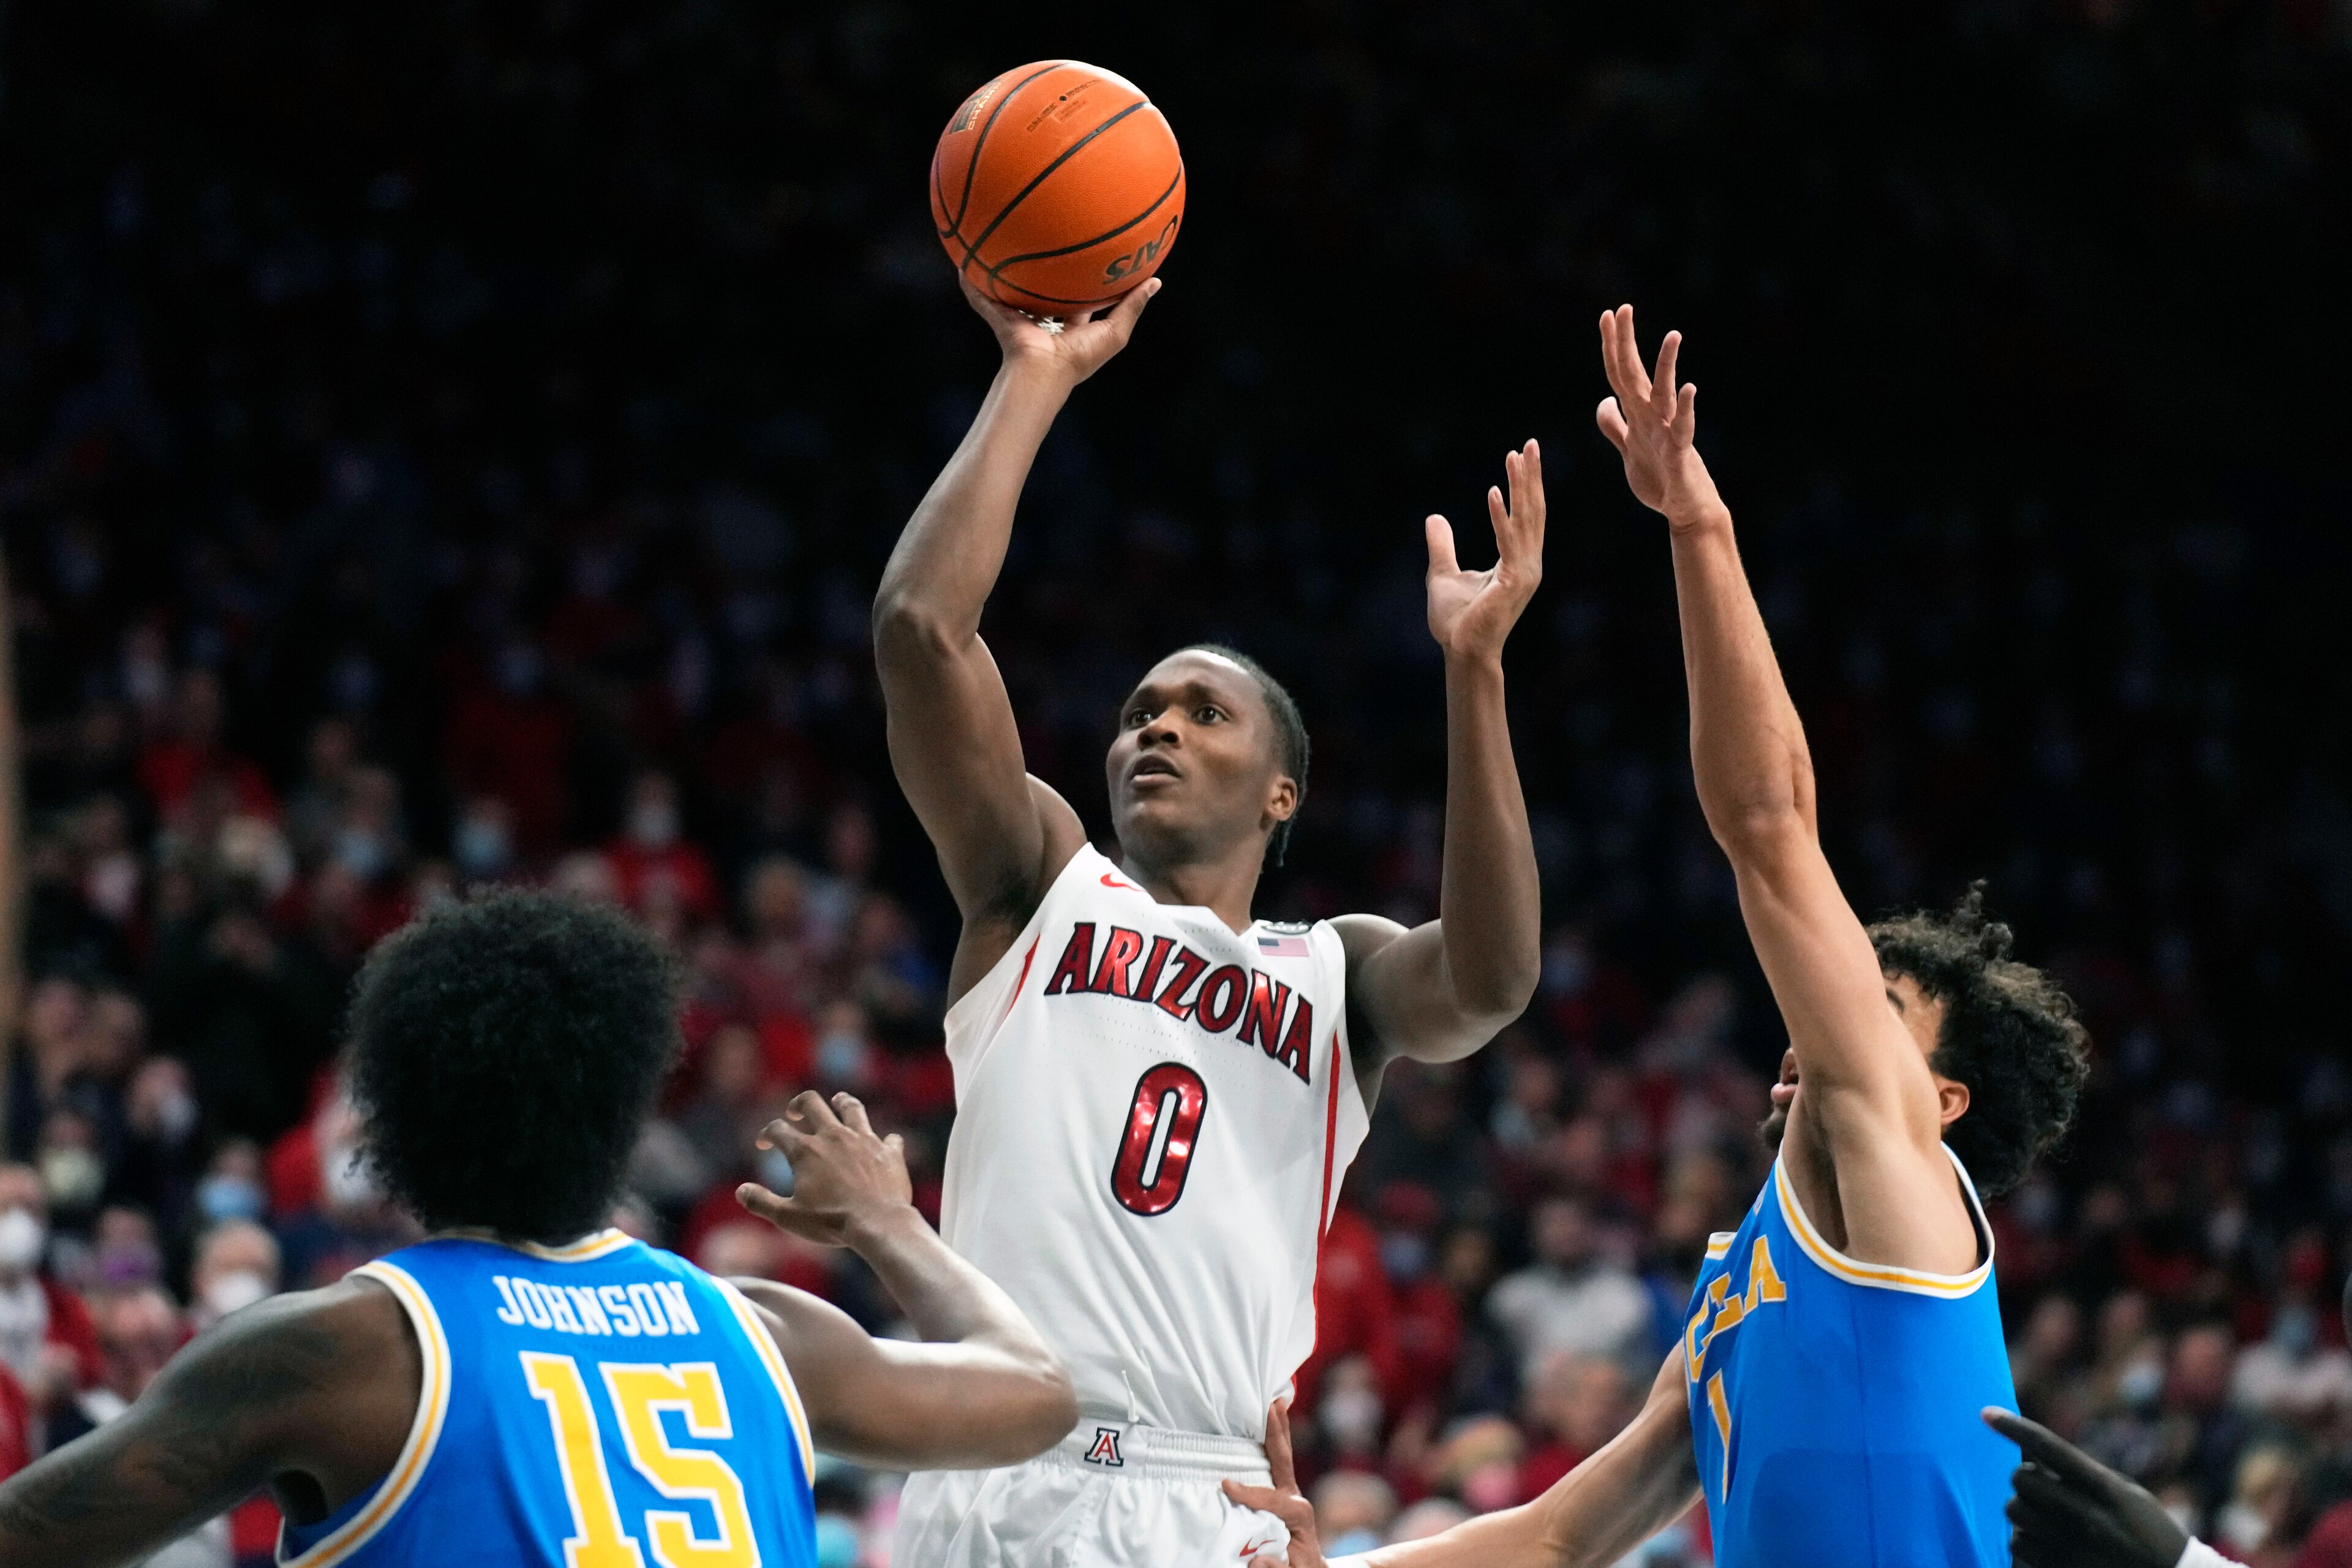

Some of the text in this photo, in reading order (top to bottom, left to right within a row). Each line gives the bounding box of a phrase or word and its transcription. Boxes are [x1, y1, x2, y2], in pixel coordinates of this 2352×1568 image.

[1044, 922, 1313, 1086] ARIZONA
[1110, 1061, 1208, 1216] 0
[492, 1276, 699, 1336] JOHNSON
[519, 1351, 761, 1568] 15
[1084, 1427, 1124, 1466] A
